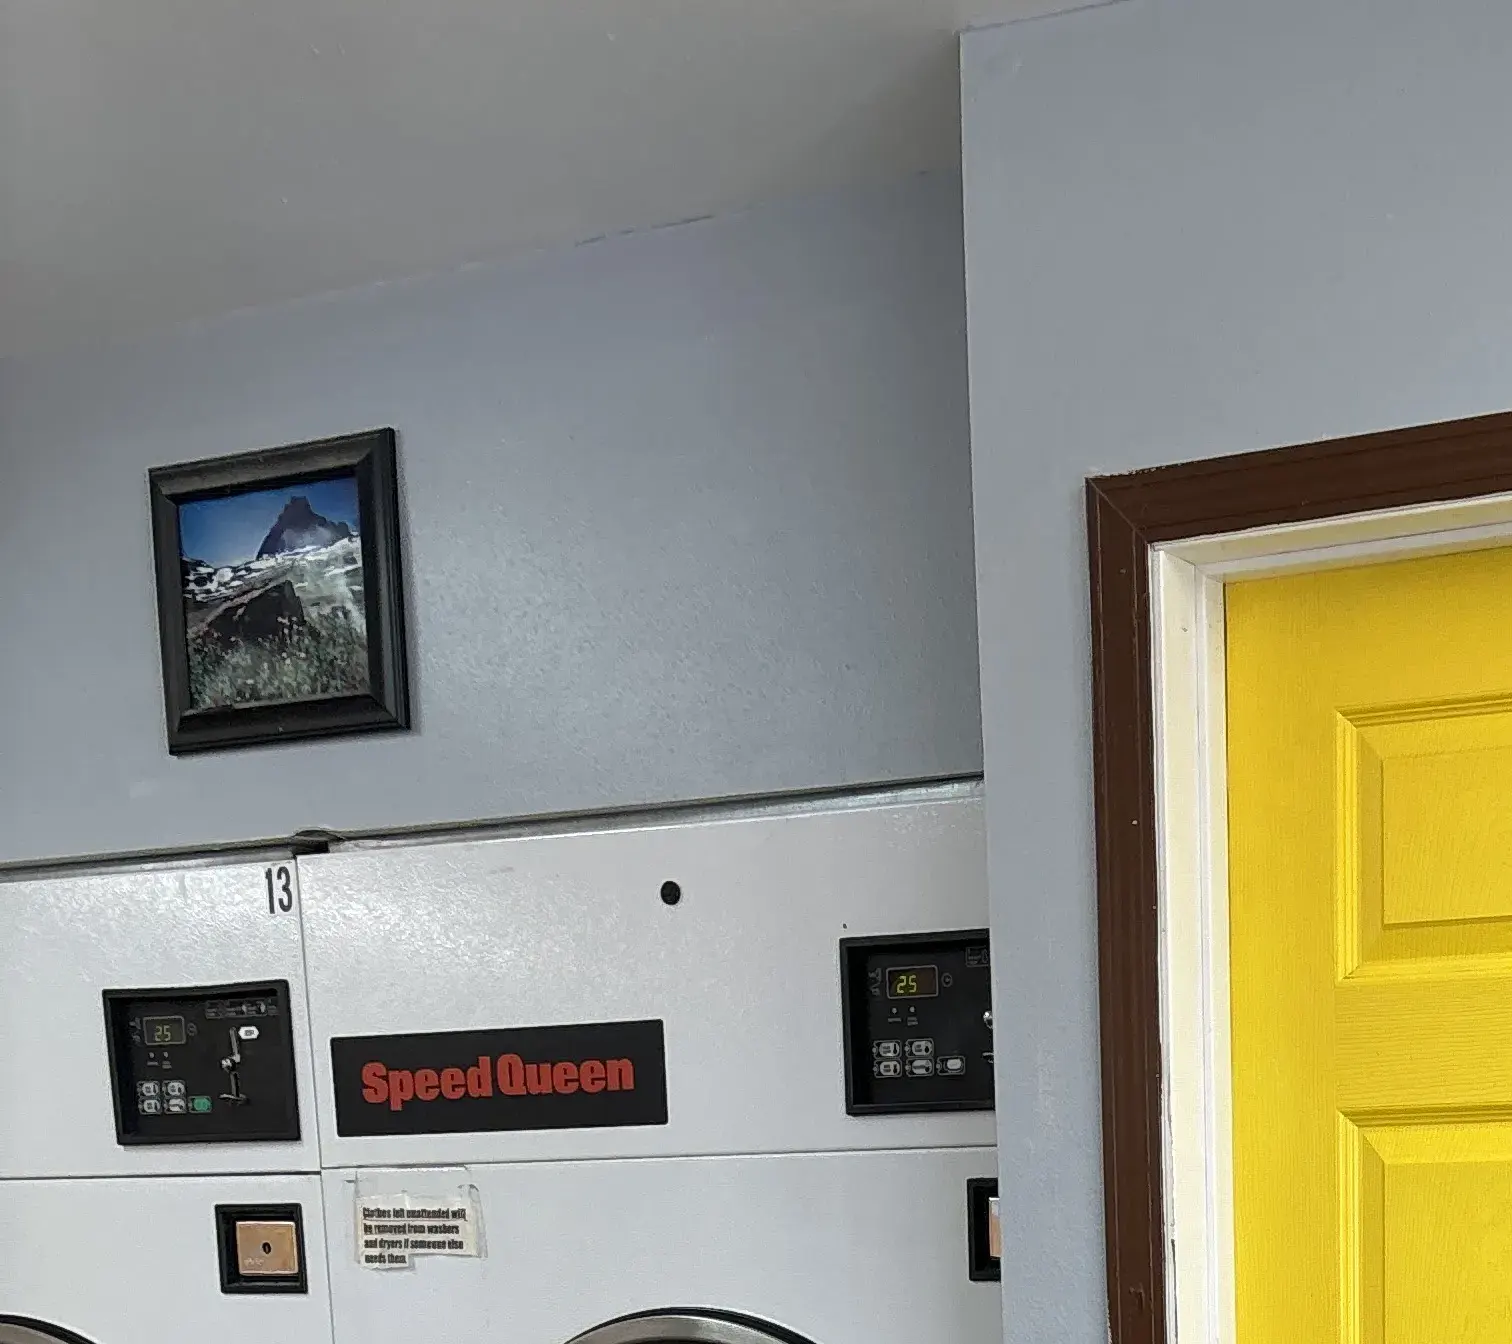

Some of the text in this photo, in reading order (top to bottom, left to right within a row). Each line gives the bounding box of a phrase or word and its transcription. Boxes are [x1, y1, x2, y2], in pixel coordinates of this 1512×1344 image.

[265, 866, 293, 914] 13
[897, 974, 917, 994] 25
[154, 1025, 172, 1042] 25
[361, 1053, 635, 1111] Speed Queen
[427, 1224, 459, 1234] washers
[379, 1238, 402, 1249] dryers
[410, 1239, 446, 1249] someone
